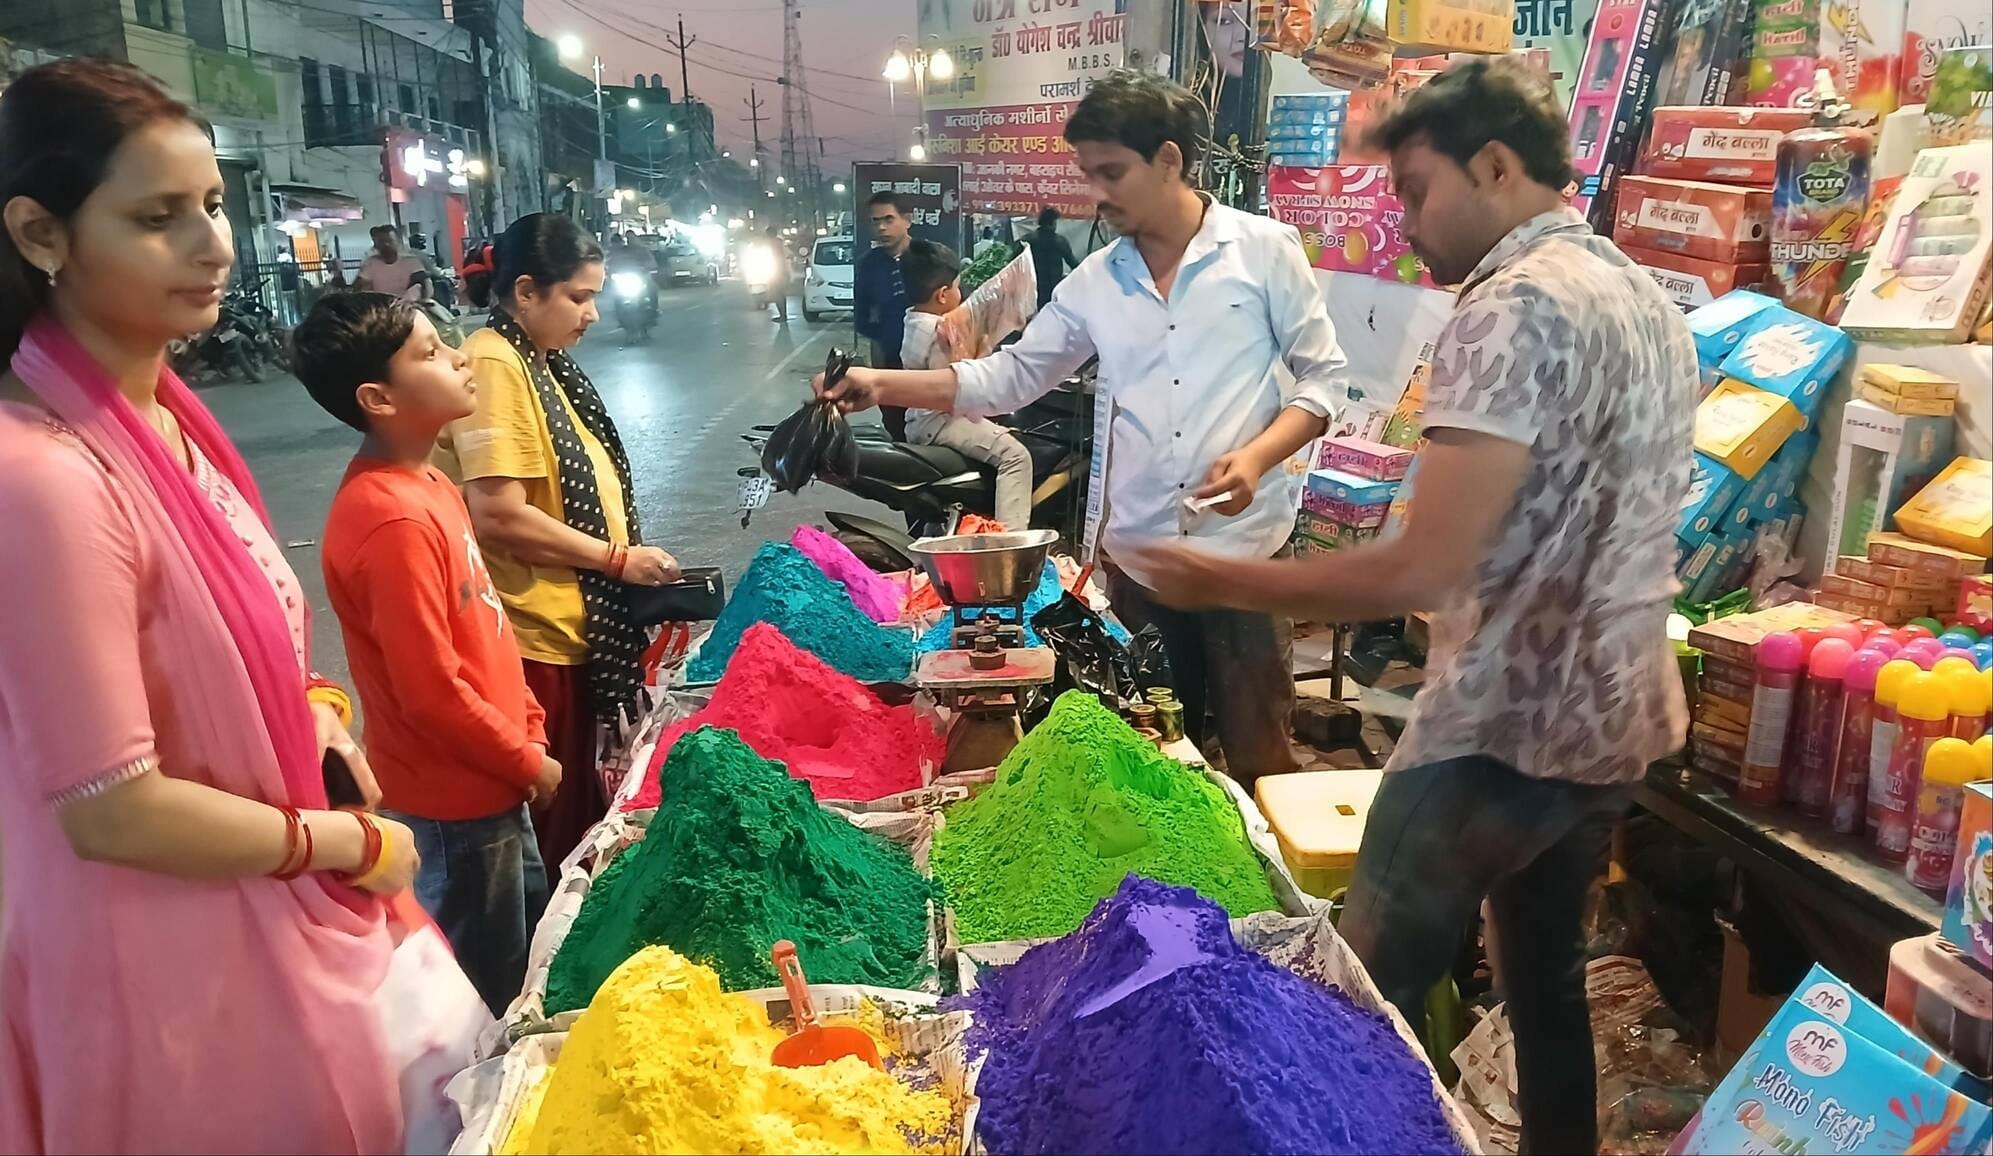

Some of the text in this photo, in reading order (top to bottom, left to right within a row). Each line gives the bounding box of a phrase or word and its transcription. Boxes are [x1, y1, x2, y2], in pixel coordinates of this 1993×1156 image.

[1015, 21, 1051, 55] योगेश
[1056, 21, 1082, 51] चन्द्र
[1068, 54, 1114, 71] M.B.B.S.
[1040, 77, 1080, 98] परामर्श
[944, 110, 1005, 131] अत्याधुनिक
[964, 134, 985, 156] आई
[988, 133, 1019, 154] केयर
[1022, 135, 1048, 154] एण्ड
[1804, 178, 1845, 189] TOTA
[1324, 195, 1376, 209] SNOW
[1285, 210, 1365, 227] COLOR
